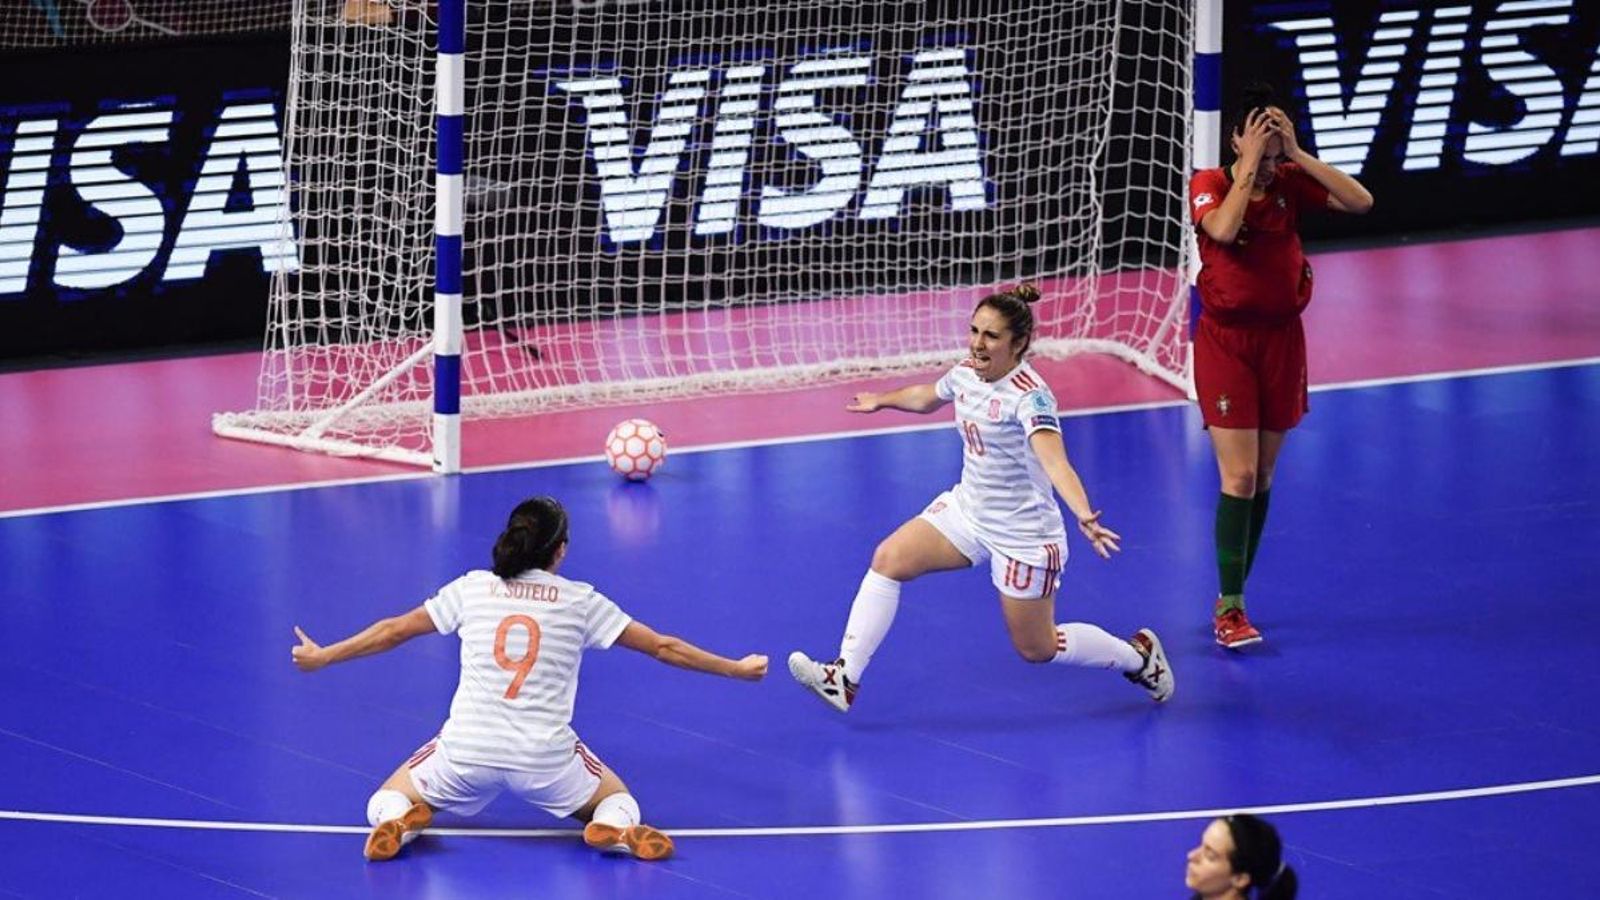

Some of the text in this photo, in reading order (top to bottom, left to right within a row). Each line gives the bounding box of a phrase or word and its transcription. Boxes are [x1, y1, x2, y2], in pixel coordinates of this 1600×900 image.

[555, 46, 987, 243] VISA
[963, 419, 985, 456] 10
[504, 581, 559, 602] SOTELO
[1004, 556, 1034, 591] 10
[493, 613, 542, 700] 9
